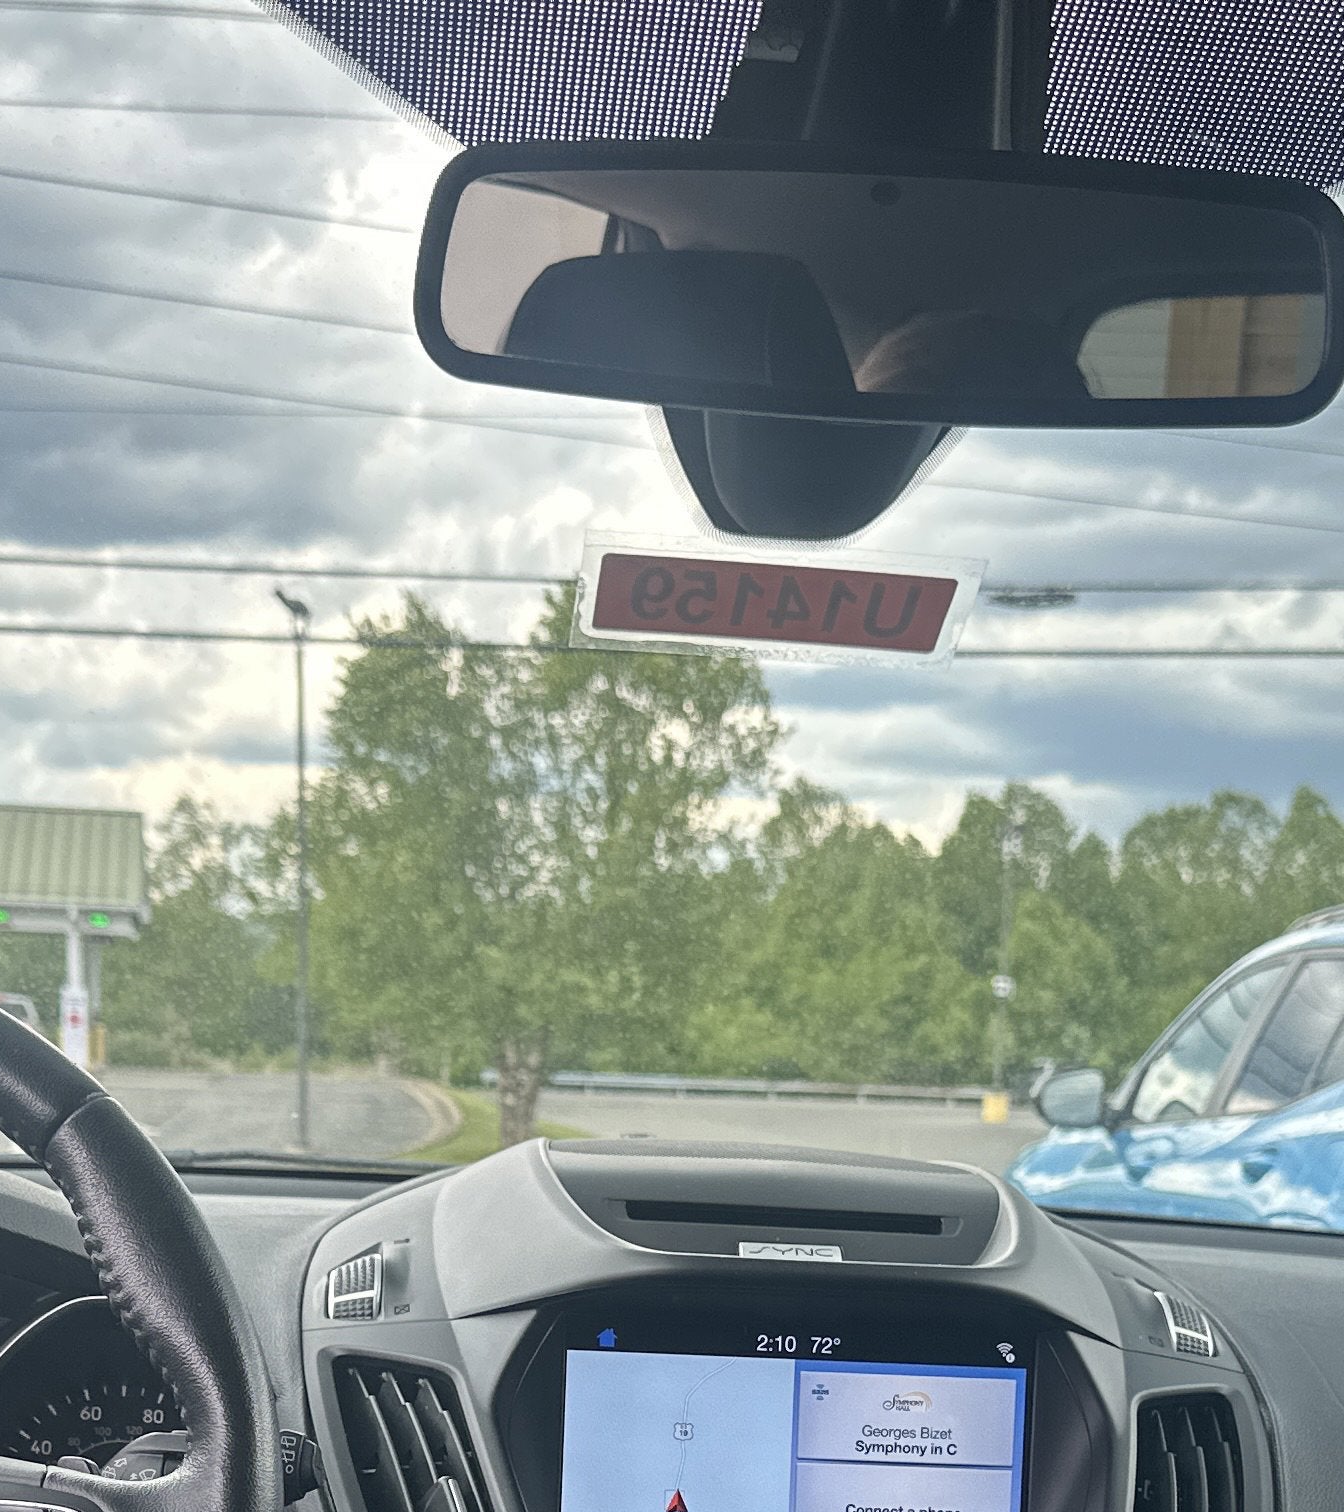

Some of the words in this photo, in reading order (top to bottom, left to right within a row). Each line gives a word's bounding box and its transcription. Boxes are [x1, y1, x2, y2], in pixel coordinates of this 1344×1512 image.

[749, 1246, 834, 1258] SYNC
[756, 1335, 797, 1353] 2:10
[811, 1335, 841, 1355] 72°
[80, 1406, 102, 1421] 60
[142, 1409, 164, 1424] 80
[94, 1426, 112, 1437] 100
[126, 1425, 143, 1436] 120
[862, 1424, 916, 1442] Georges
[919, 1426, 953, 1441] Bizet
[30, 1439, 52, 1455] 40
[855, 1440, 926, 1458] Symphony
[930, 1441, 944, 1455] in
[946, 1443, 957, 1456] C
